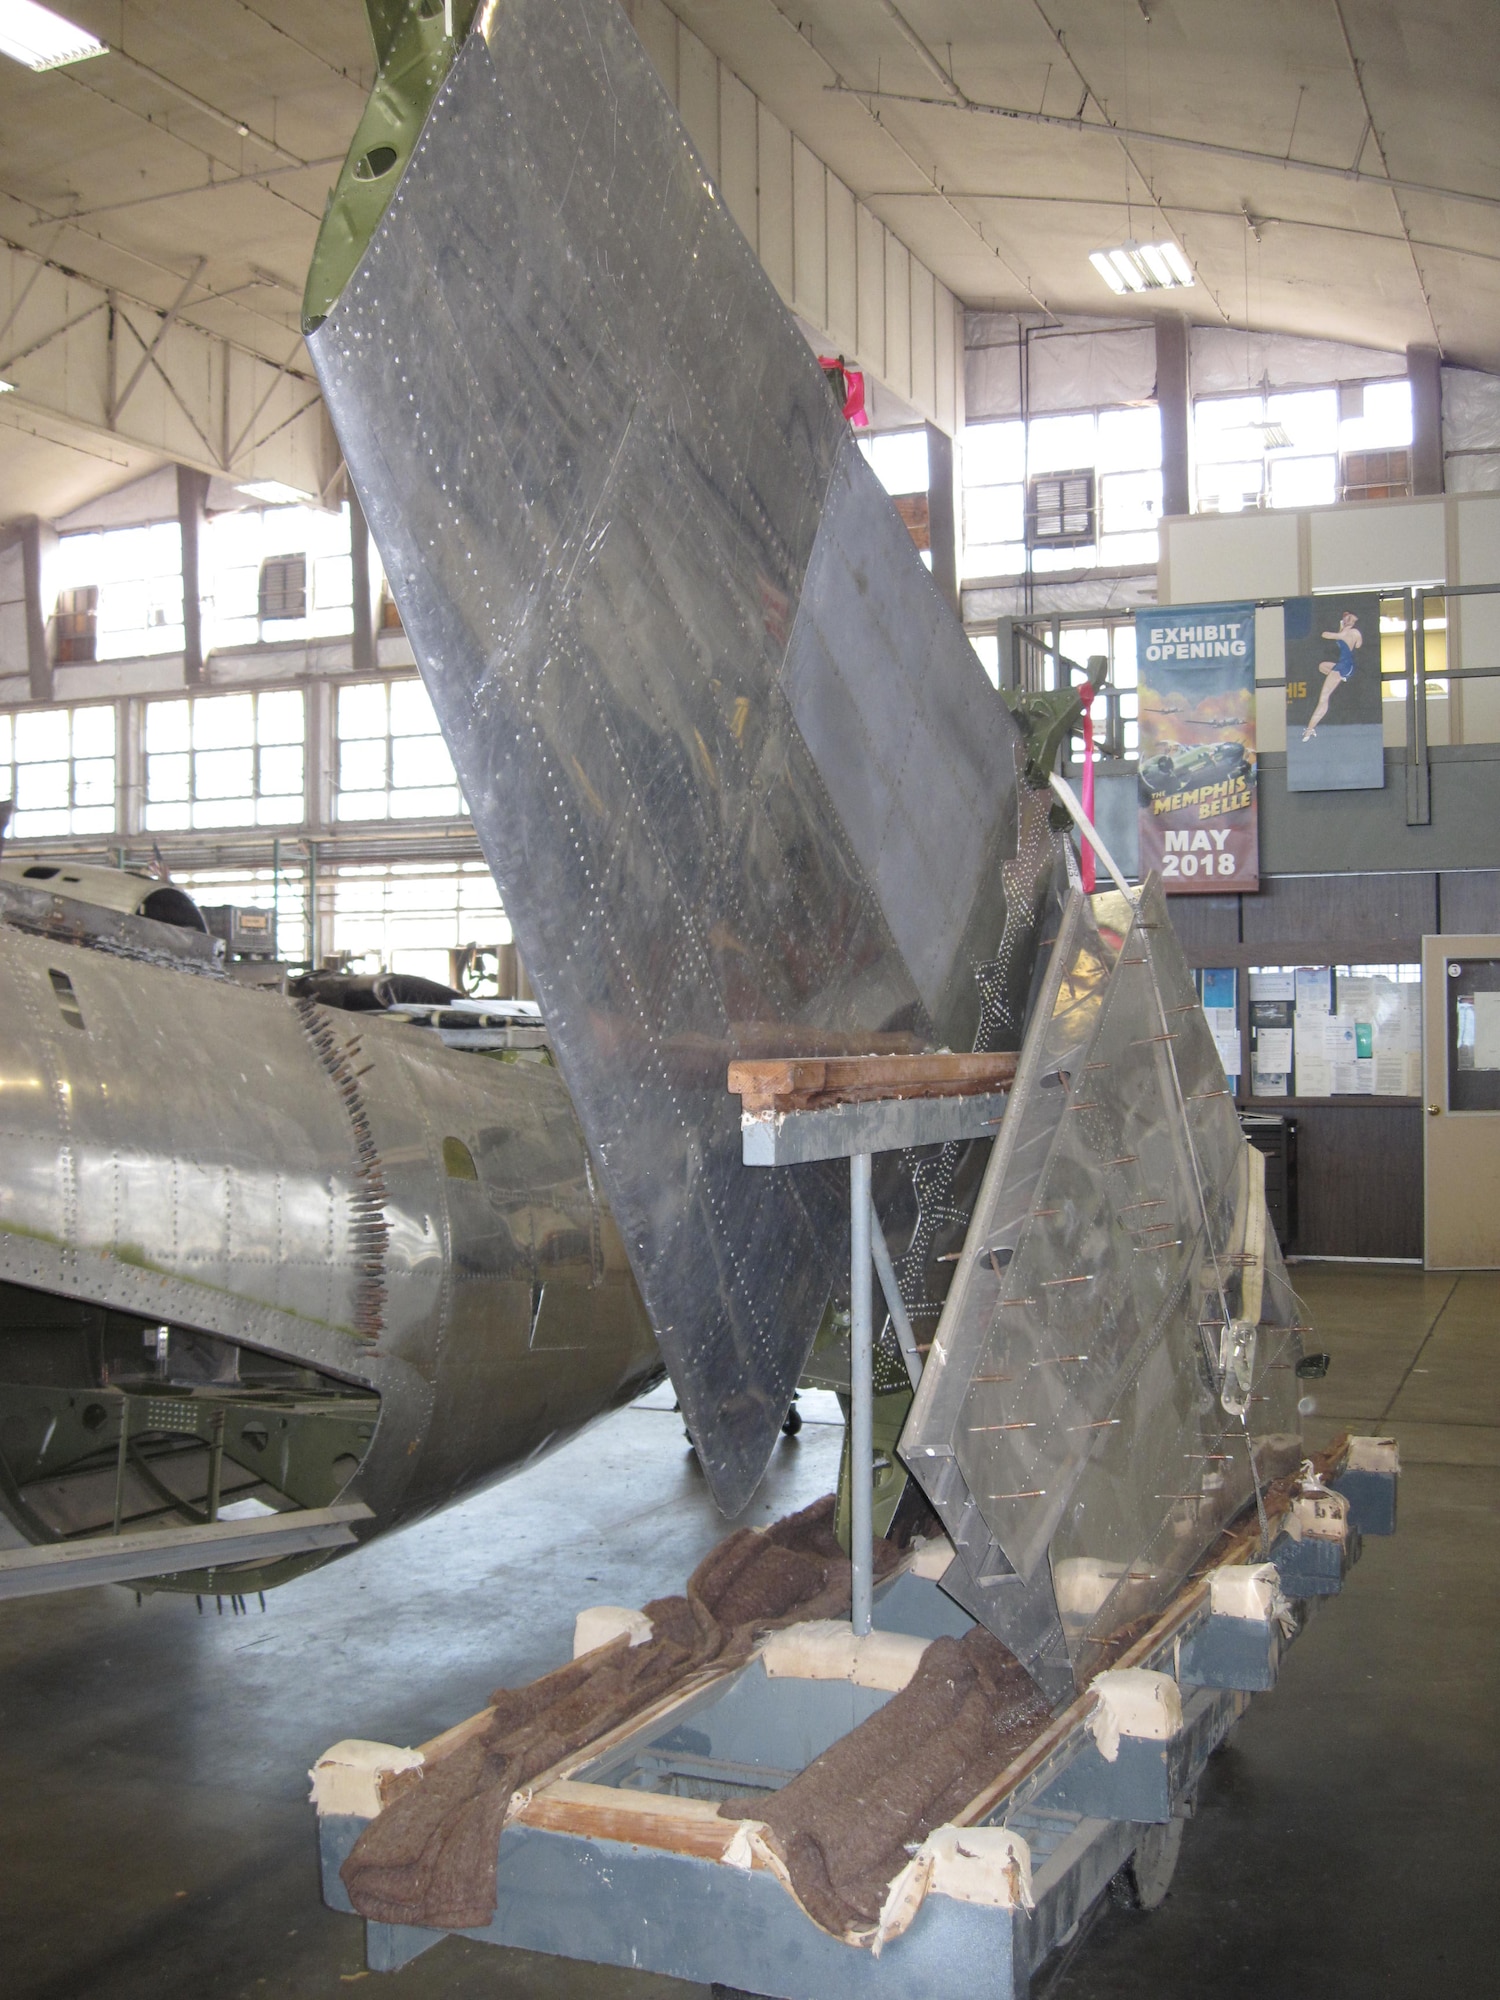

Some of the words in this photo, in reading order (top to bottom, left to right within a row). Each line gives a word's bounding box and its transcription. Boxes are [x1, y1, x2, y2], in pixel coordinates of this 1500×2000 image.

[1150, 623, 1241, 645] EXHIBIT
[1145, 640, 1247, 662] OPENING
[1151, 790, 1167, 800] THE
[1153, 775, 1247, 815] MEMPHIS
[1199, 790, 1252, 820] BELLE
[1164, 828, 1232, 852] MAY
[1161, 853, 1236, 877] 2018
